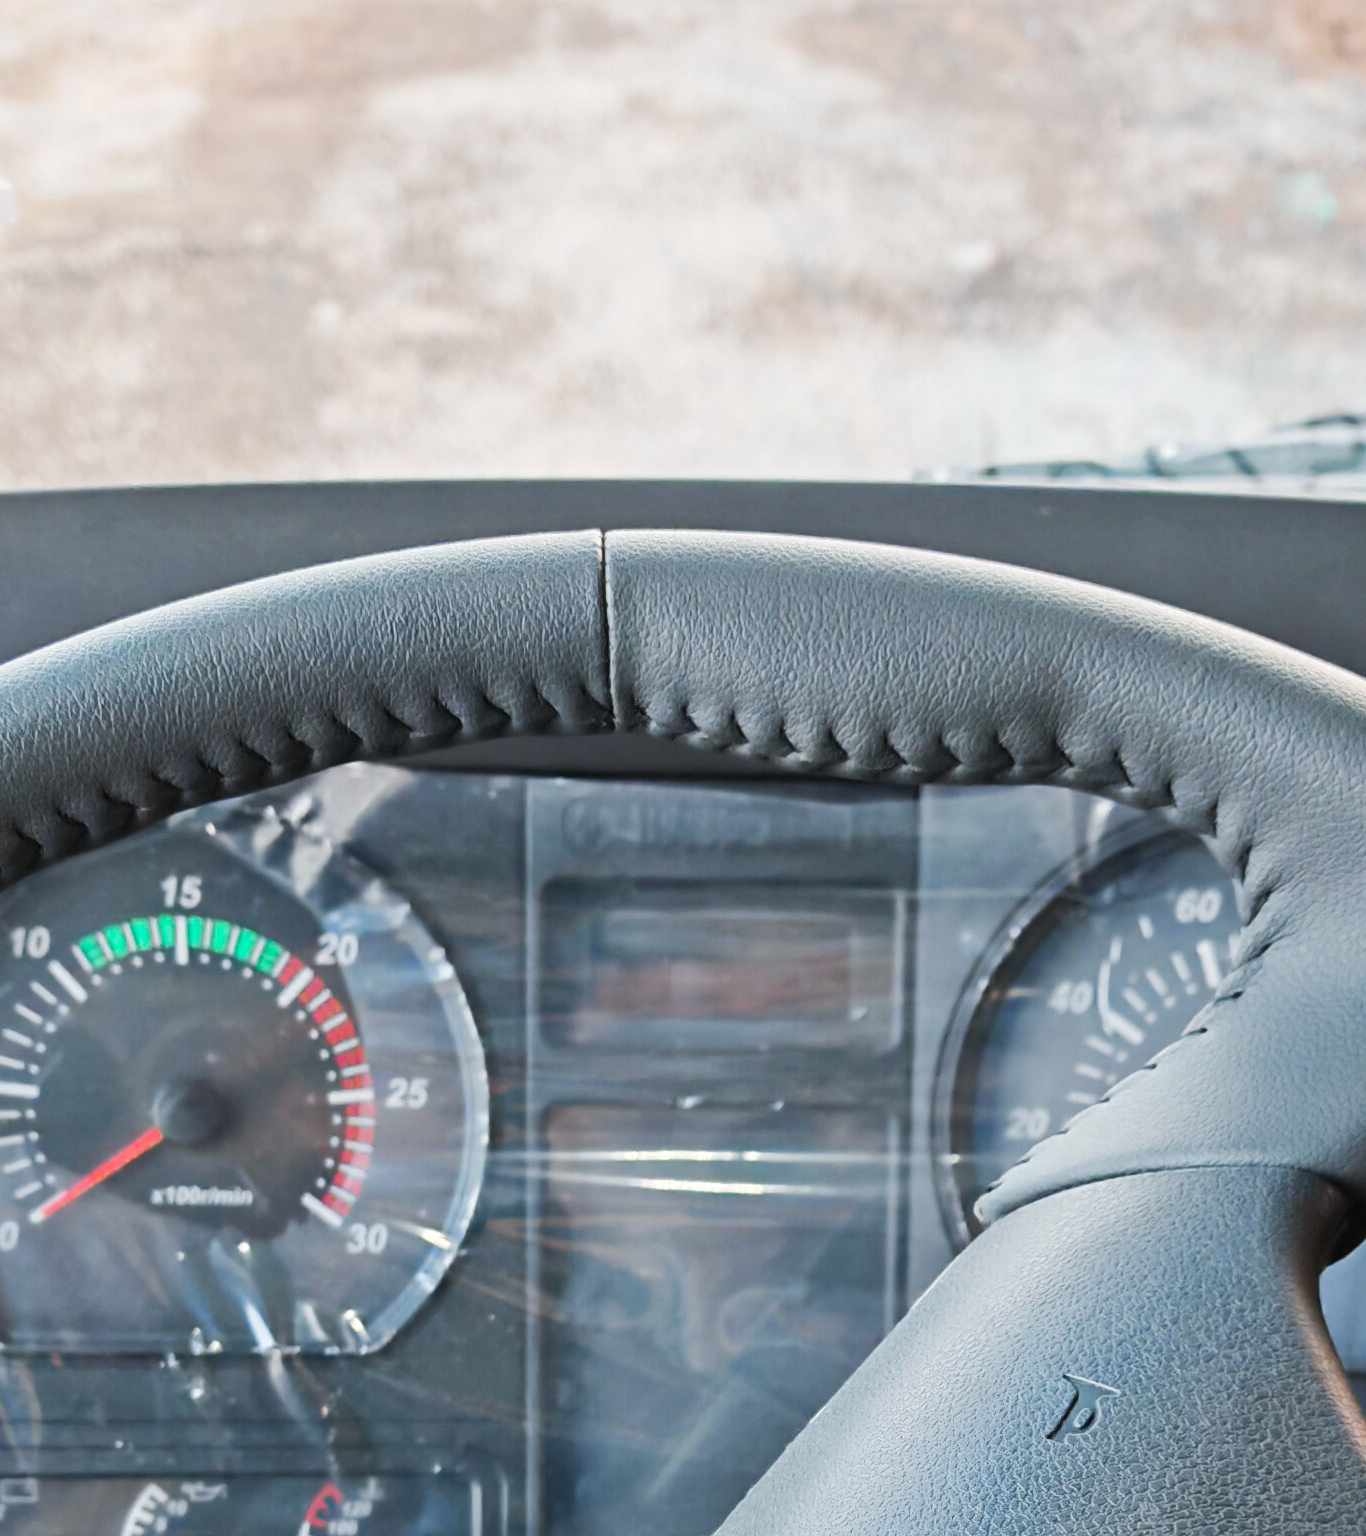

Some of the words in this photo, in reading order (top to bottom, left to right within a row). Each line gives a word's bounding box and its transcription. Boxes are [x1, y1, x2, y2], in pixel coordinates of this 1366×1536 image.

[161, 876, 202, 909] 15
[1175, 888, 1223, 924] 60
[11, 926, 51, 959] 10
[318, 932, 359, 966] 20
[1048, 979, 1095, 1015] 40
[386, 1079, 428, 1110] 25
[1004, 1107, 1051, 1141] 20
[346, 1224, 388, 1255] 30
